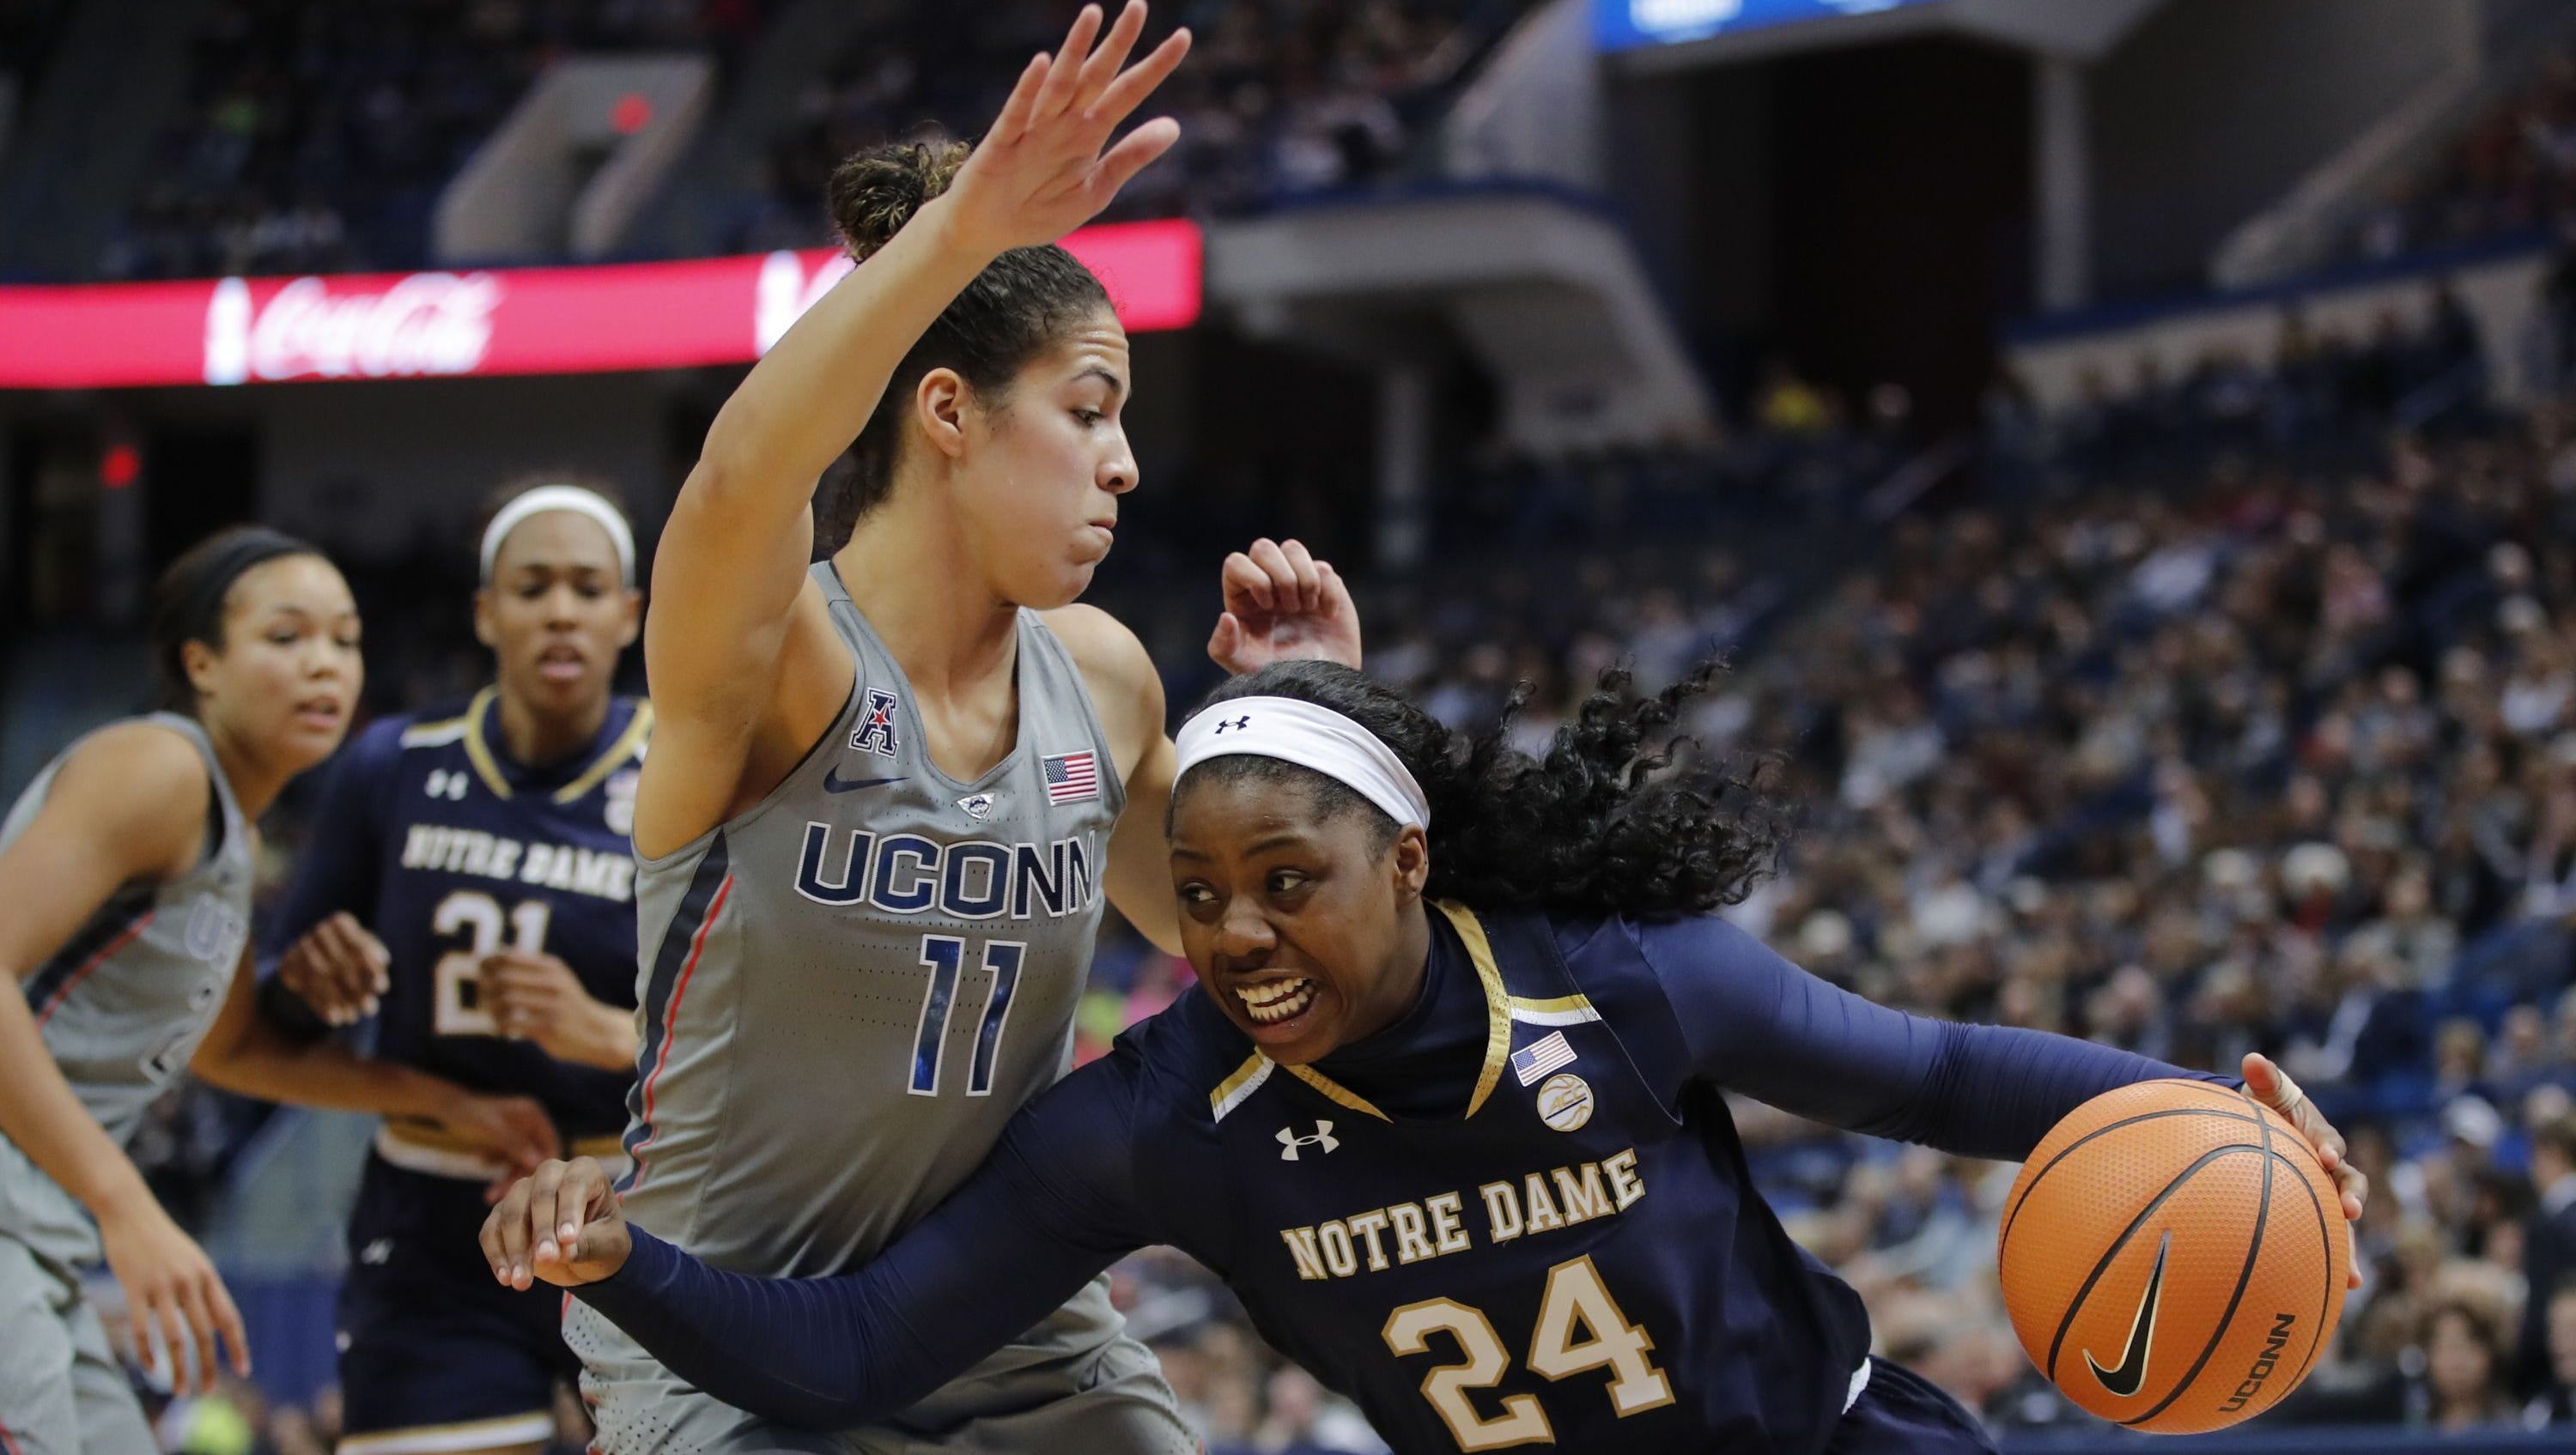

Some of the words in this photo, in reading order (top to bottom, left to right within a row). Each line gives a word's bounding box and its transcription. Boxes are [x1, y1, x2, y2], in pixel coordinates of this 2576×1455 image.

[401, 824, 523, 881] NOTRE
[519, 841, 637, 902] DAME
[794, 821, 1097, 920] UCONN
[907, 933, 1028, 1097] 11
[1280, 1191, 1471, 1280] NOTRE
[1479, 1148, 1646, 1244] DAME
[1381, 1253, 1676, 1453] 24
[2218, 1313, 2296, 1413] UCONN
